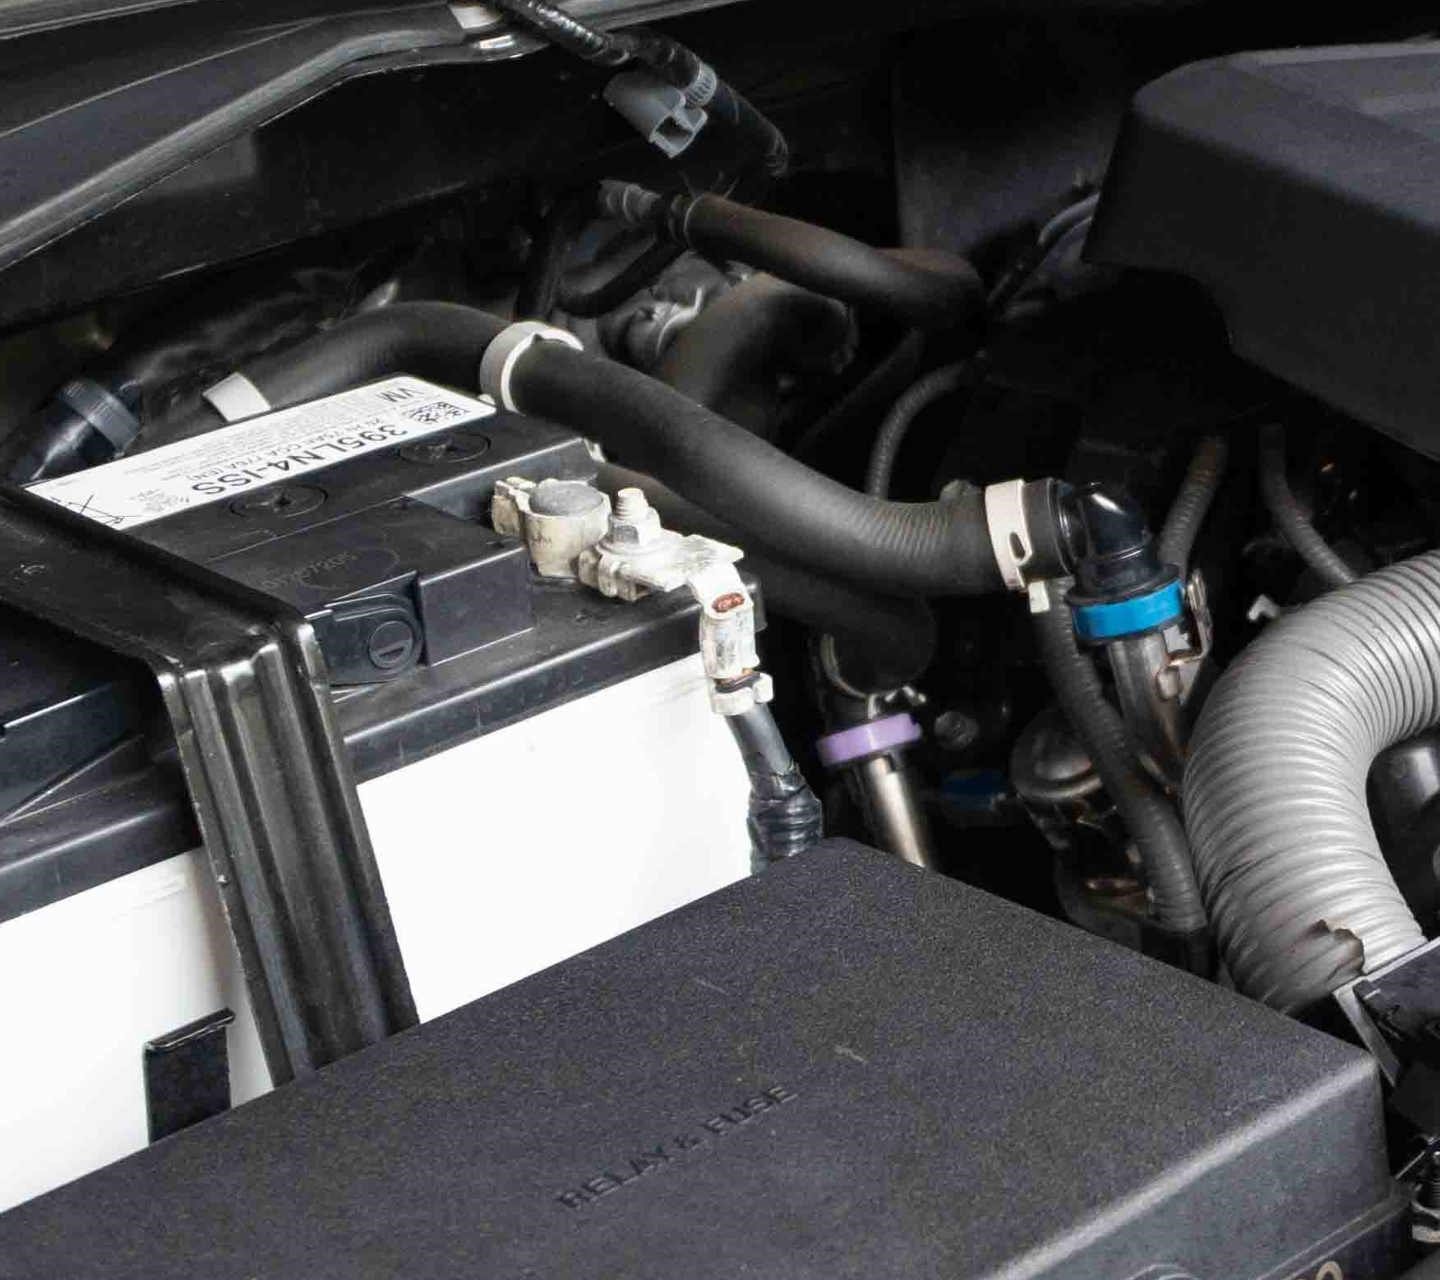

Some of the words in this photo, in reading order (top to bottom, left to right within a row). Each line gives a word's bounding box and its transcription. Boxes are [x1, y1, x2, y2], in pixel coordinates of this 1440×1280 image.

[374, 387, 426, 402] VM
[191, 424, 409, 495] 395LN4-ISS
[554, 1144, 674, 1210] RELAY
[701, 1086, 799, 1137] FUSE
